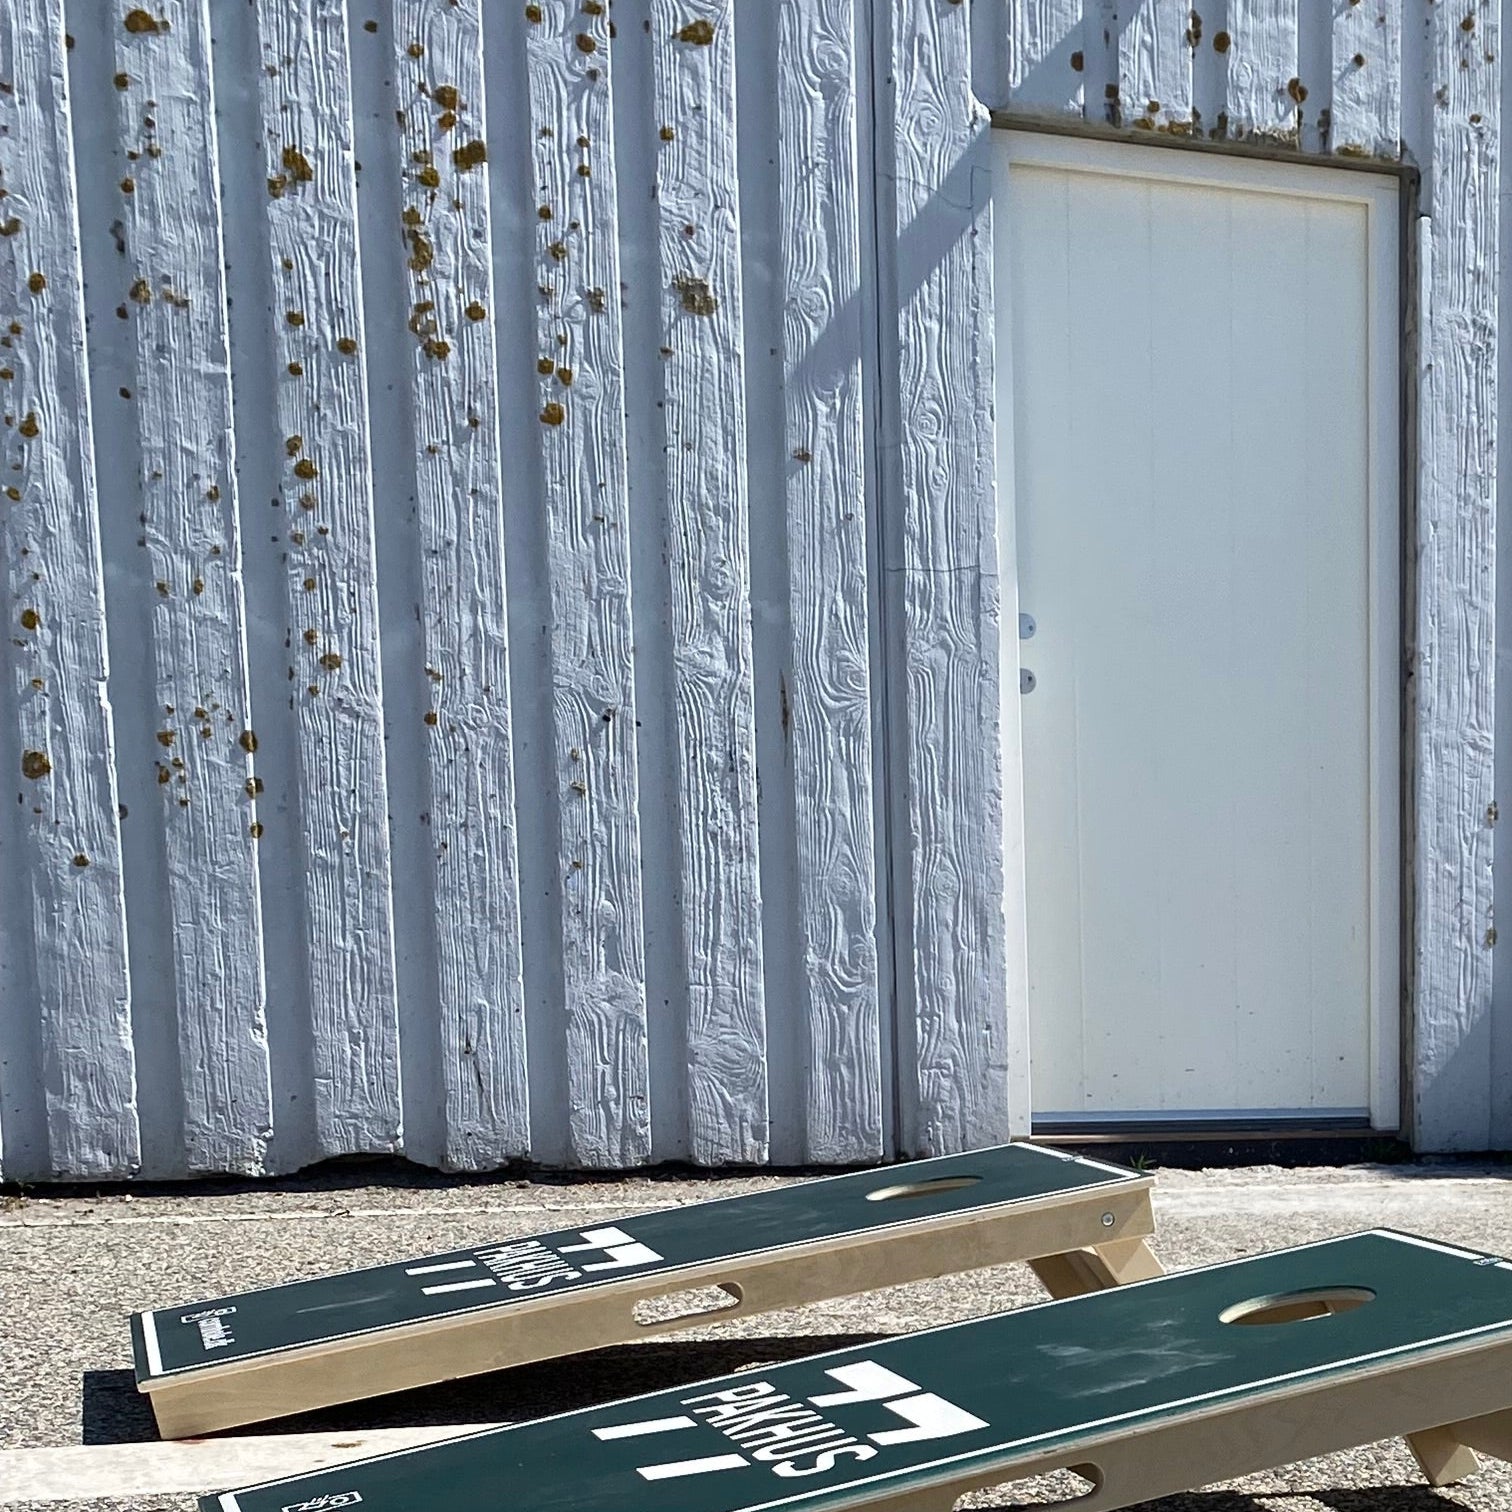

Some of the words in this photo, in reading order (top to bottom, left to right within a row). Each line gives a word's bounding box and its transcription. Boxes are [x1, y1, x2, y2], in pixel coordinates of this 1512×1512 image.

[473, 1241, 582, 1291] PAKHUS
[591, 1360, 990, 1480] 77
[680, 1381, 879, 1477] PAKHUS
